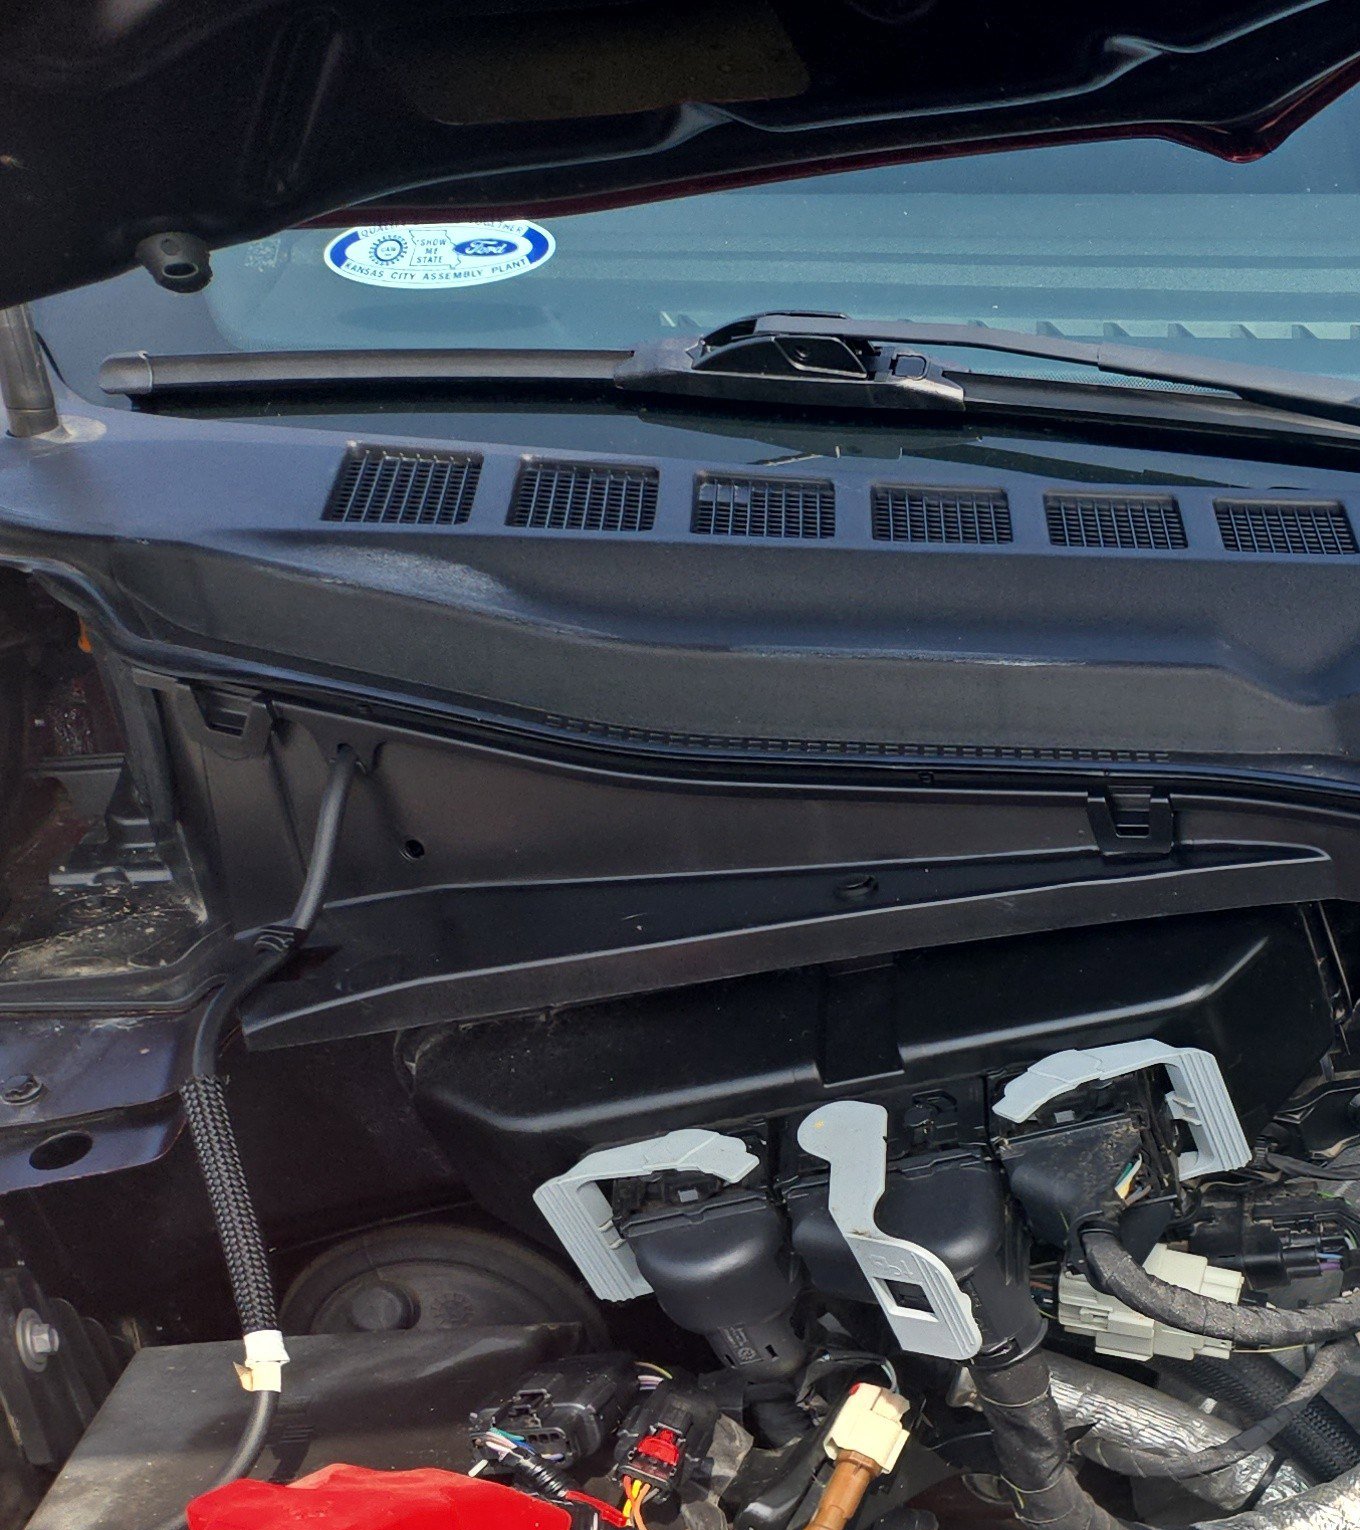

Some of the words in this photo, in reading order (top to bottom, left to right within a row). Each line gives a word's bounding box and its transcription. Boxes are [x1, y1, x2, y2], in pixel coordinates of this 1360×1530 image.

[465, 240, 508, 255] Ford
[416, 256, 443, 264] STATE
[345, 262, 384, 278] KANSAS
[390, 271, 416, 280] CITY
[422, 269, 483, 280] ASSEMBLY
[491, 257, 527, 274] PLANT
